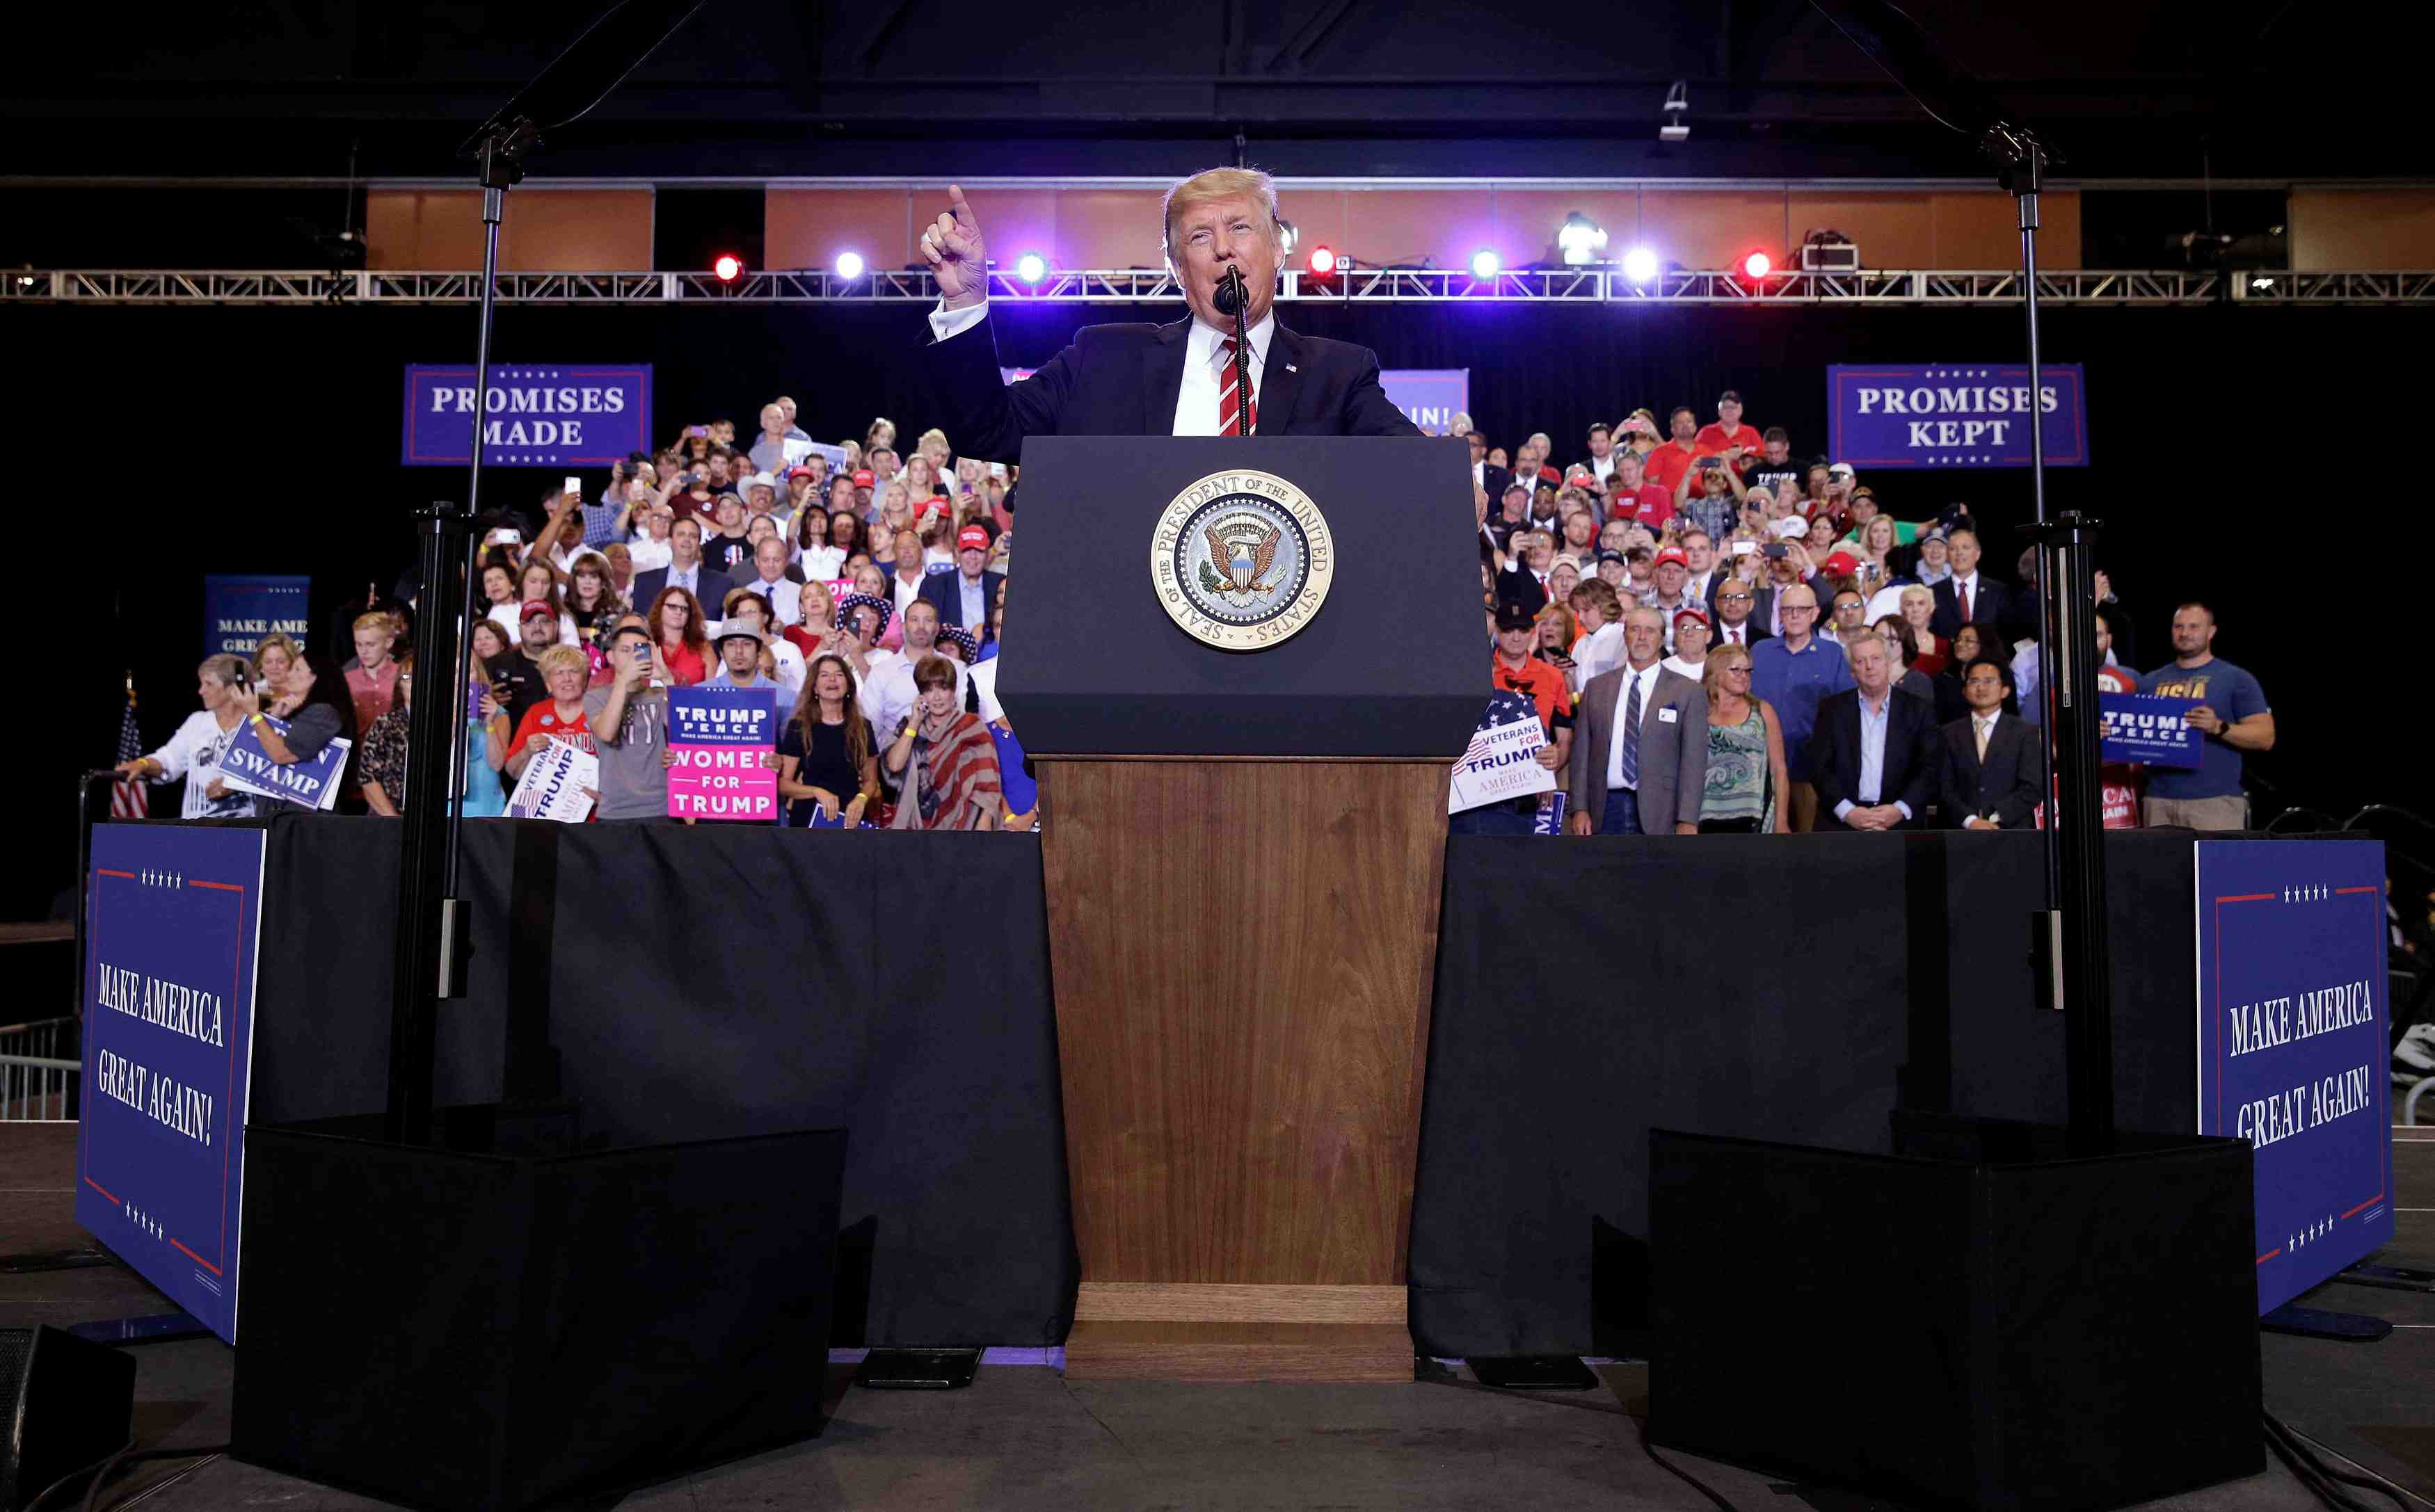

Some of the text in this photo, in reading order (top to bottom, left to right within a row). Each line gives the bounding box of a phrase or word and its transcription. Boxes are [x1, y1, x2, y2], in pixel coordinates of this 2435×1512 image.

[431, 387, 625, 413] PROMISES
[1858, 387, 2058, 414] PROMISES
[471, 420, 583, 445] MADE
[1908, 420, 2009, 447] KEPT
[1158, 476, 1327, 641] SEAL OF THE PRESIDENT OF THE UNITED STATES
[217, 619, 267, 633] MAKE
[222, 638, 257, 652] GRE
[676, 707, 767, 723] TRUMP
[684, 722, 758, 734] PENCE
[1483, 723, 1538, 745] VETERANS
[1519, 734, 1540, 746] FOR
[2110, 726, 2187, 741] PENCE
[548, 746, 563, 765] FOR
[229, 748, 320, 794] SWAMP
[534, 748, 573, 818] TRUMP
[701, 775, 740, 789] FOR
[674, 794, 770, 813] TRUMP
[98, 963, 223, 1047] MAKE AMERICA
[2230, 980, 2373, 1057] MAKE AMERICA
[99, 1048, 212, 1147] GREAT AGAIN!
[2237, 1065, 2369, 1150] GREAT AGAIN!
